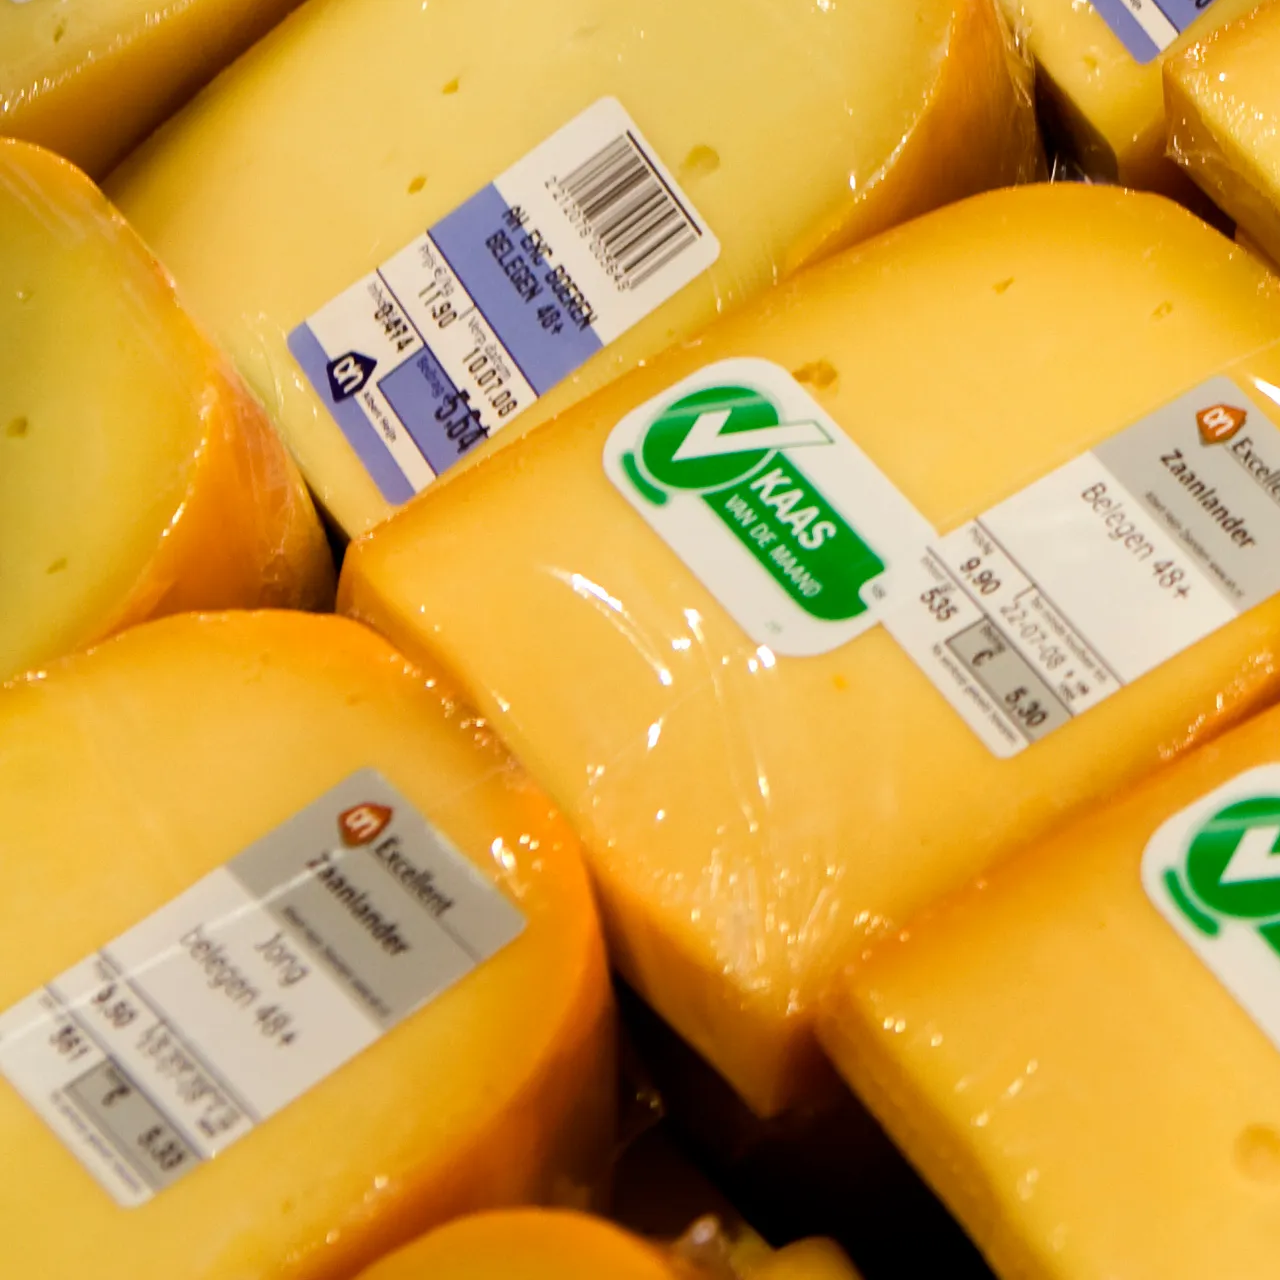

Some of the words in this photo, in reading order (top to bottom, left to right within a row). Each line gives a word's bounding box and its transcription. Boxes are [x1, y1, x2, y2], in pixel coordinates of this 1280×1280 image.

[485, 230, 543, 302] BELEGEN
[535, 300, 568, 337] 48+
[502, 203, 529, 231] AH
[519, 230, 553, 267] EXC
[544, 265, 597, 330] BOEREN
[416, 281, 458, 329] 11.90
[461, 347, 517, 418] 10.07.08
[432, 388, 490, 453] 5.64
[723, 494, 756, 527] VAN
[750, 522, 776, 548] DE
[769, 543, 822, 598] MAAND
[751, 464, 836, 554] KAAS
[1078, 483, 1159, 559] Belegen
[1146, 556, 1198, 602] 48+
[1158, 450, 1259, 550] Zaanlander
[956, 556, 1003, 596] 9,90
[917, 586, 960, 623] 535
[1001, 686, 1050, 729] 5,30
[302, 853, 415, 958] Zaanlander
[372, 838, 458, 915] Excellent
[171, 927, 262, 1012] belegen
[247, 931, 314, 990] Jong
